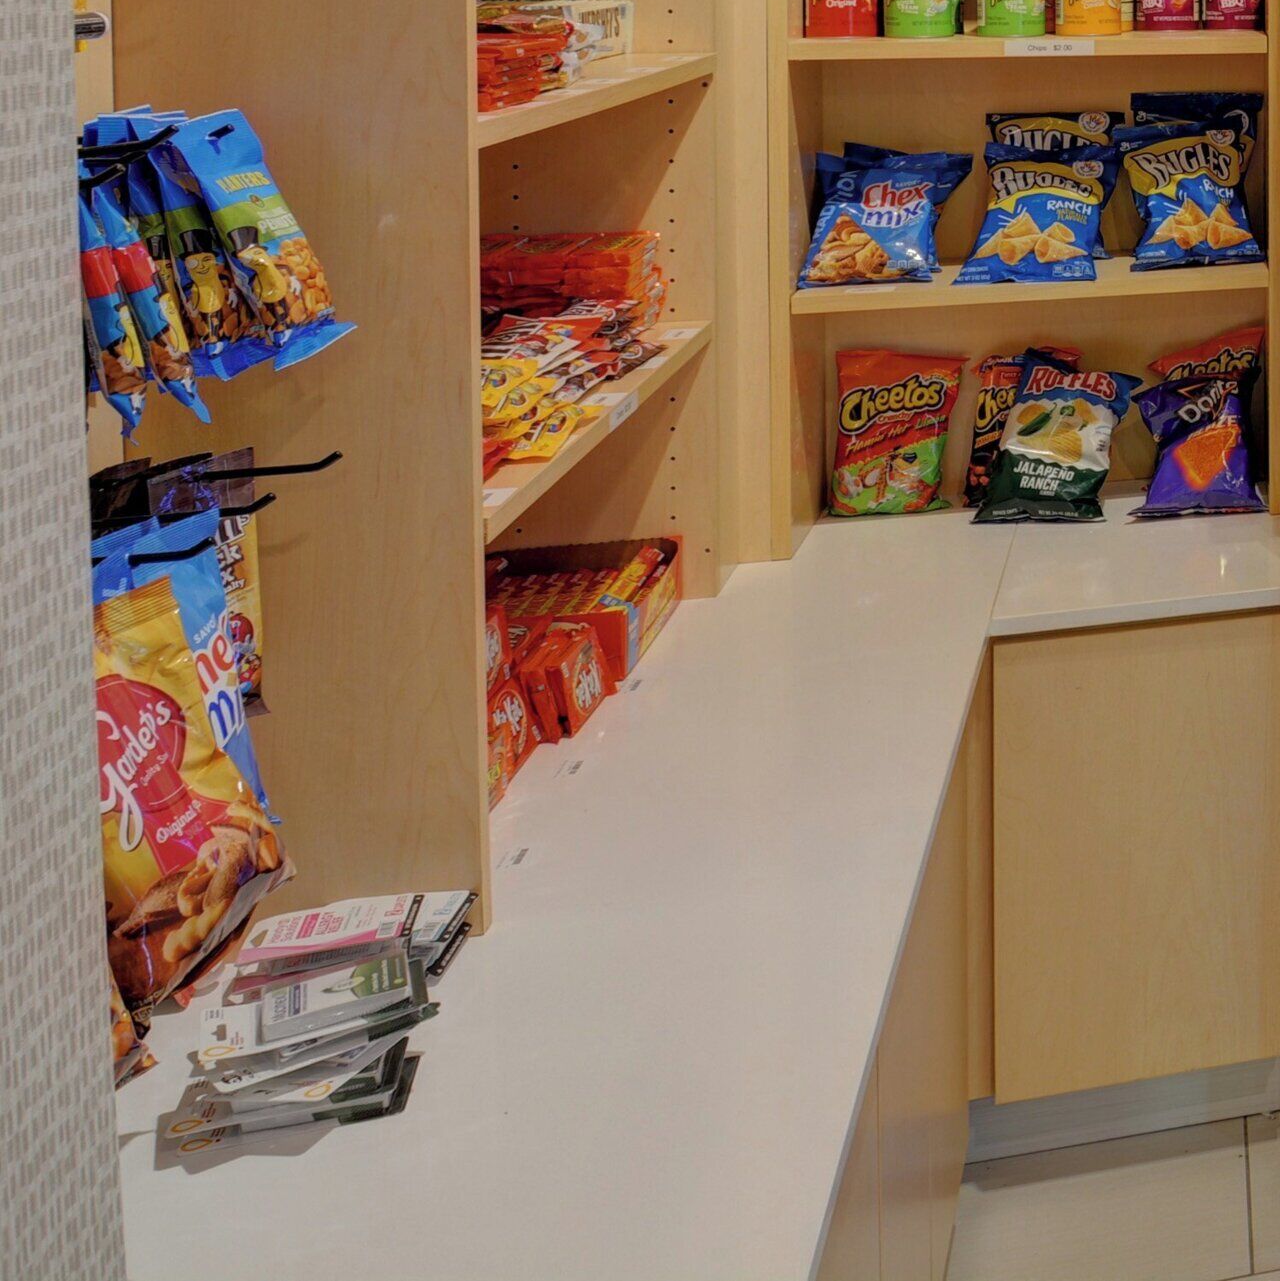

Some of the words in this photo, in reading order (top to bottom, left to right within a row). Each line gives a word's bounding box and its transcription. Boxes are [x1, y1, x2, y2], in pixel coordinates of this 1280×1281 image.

[1027, 44, 1048, 53] Chips
[1053, 44, 1073, 53] $2.00
[1134, 147, 1231, 187] BUGLES
[863, 180, 934, 210] Chex
[1047, 199, 1092, 216] RANCH
[1026, 365, 1118, 402] RUFFLES
[841, 380, 942, 428] Cheetos
[1014, 459, 1076, 484] JALAPEÑO
[1020, 476, 1061, 492] RANCH
[156, 801, 200, 844] Original
